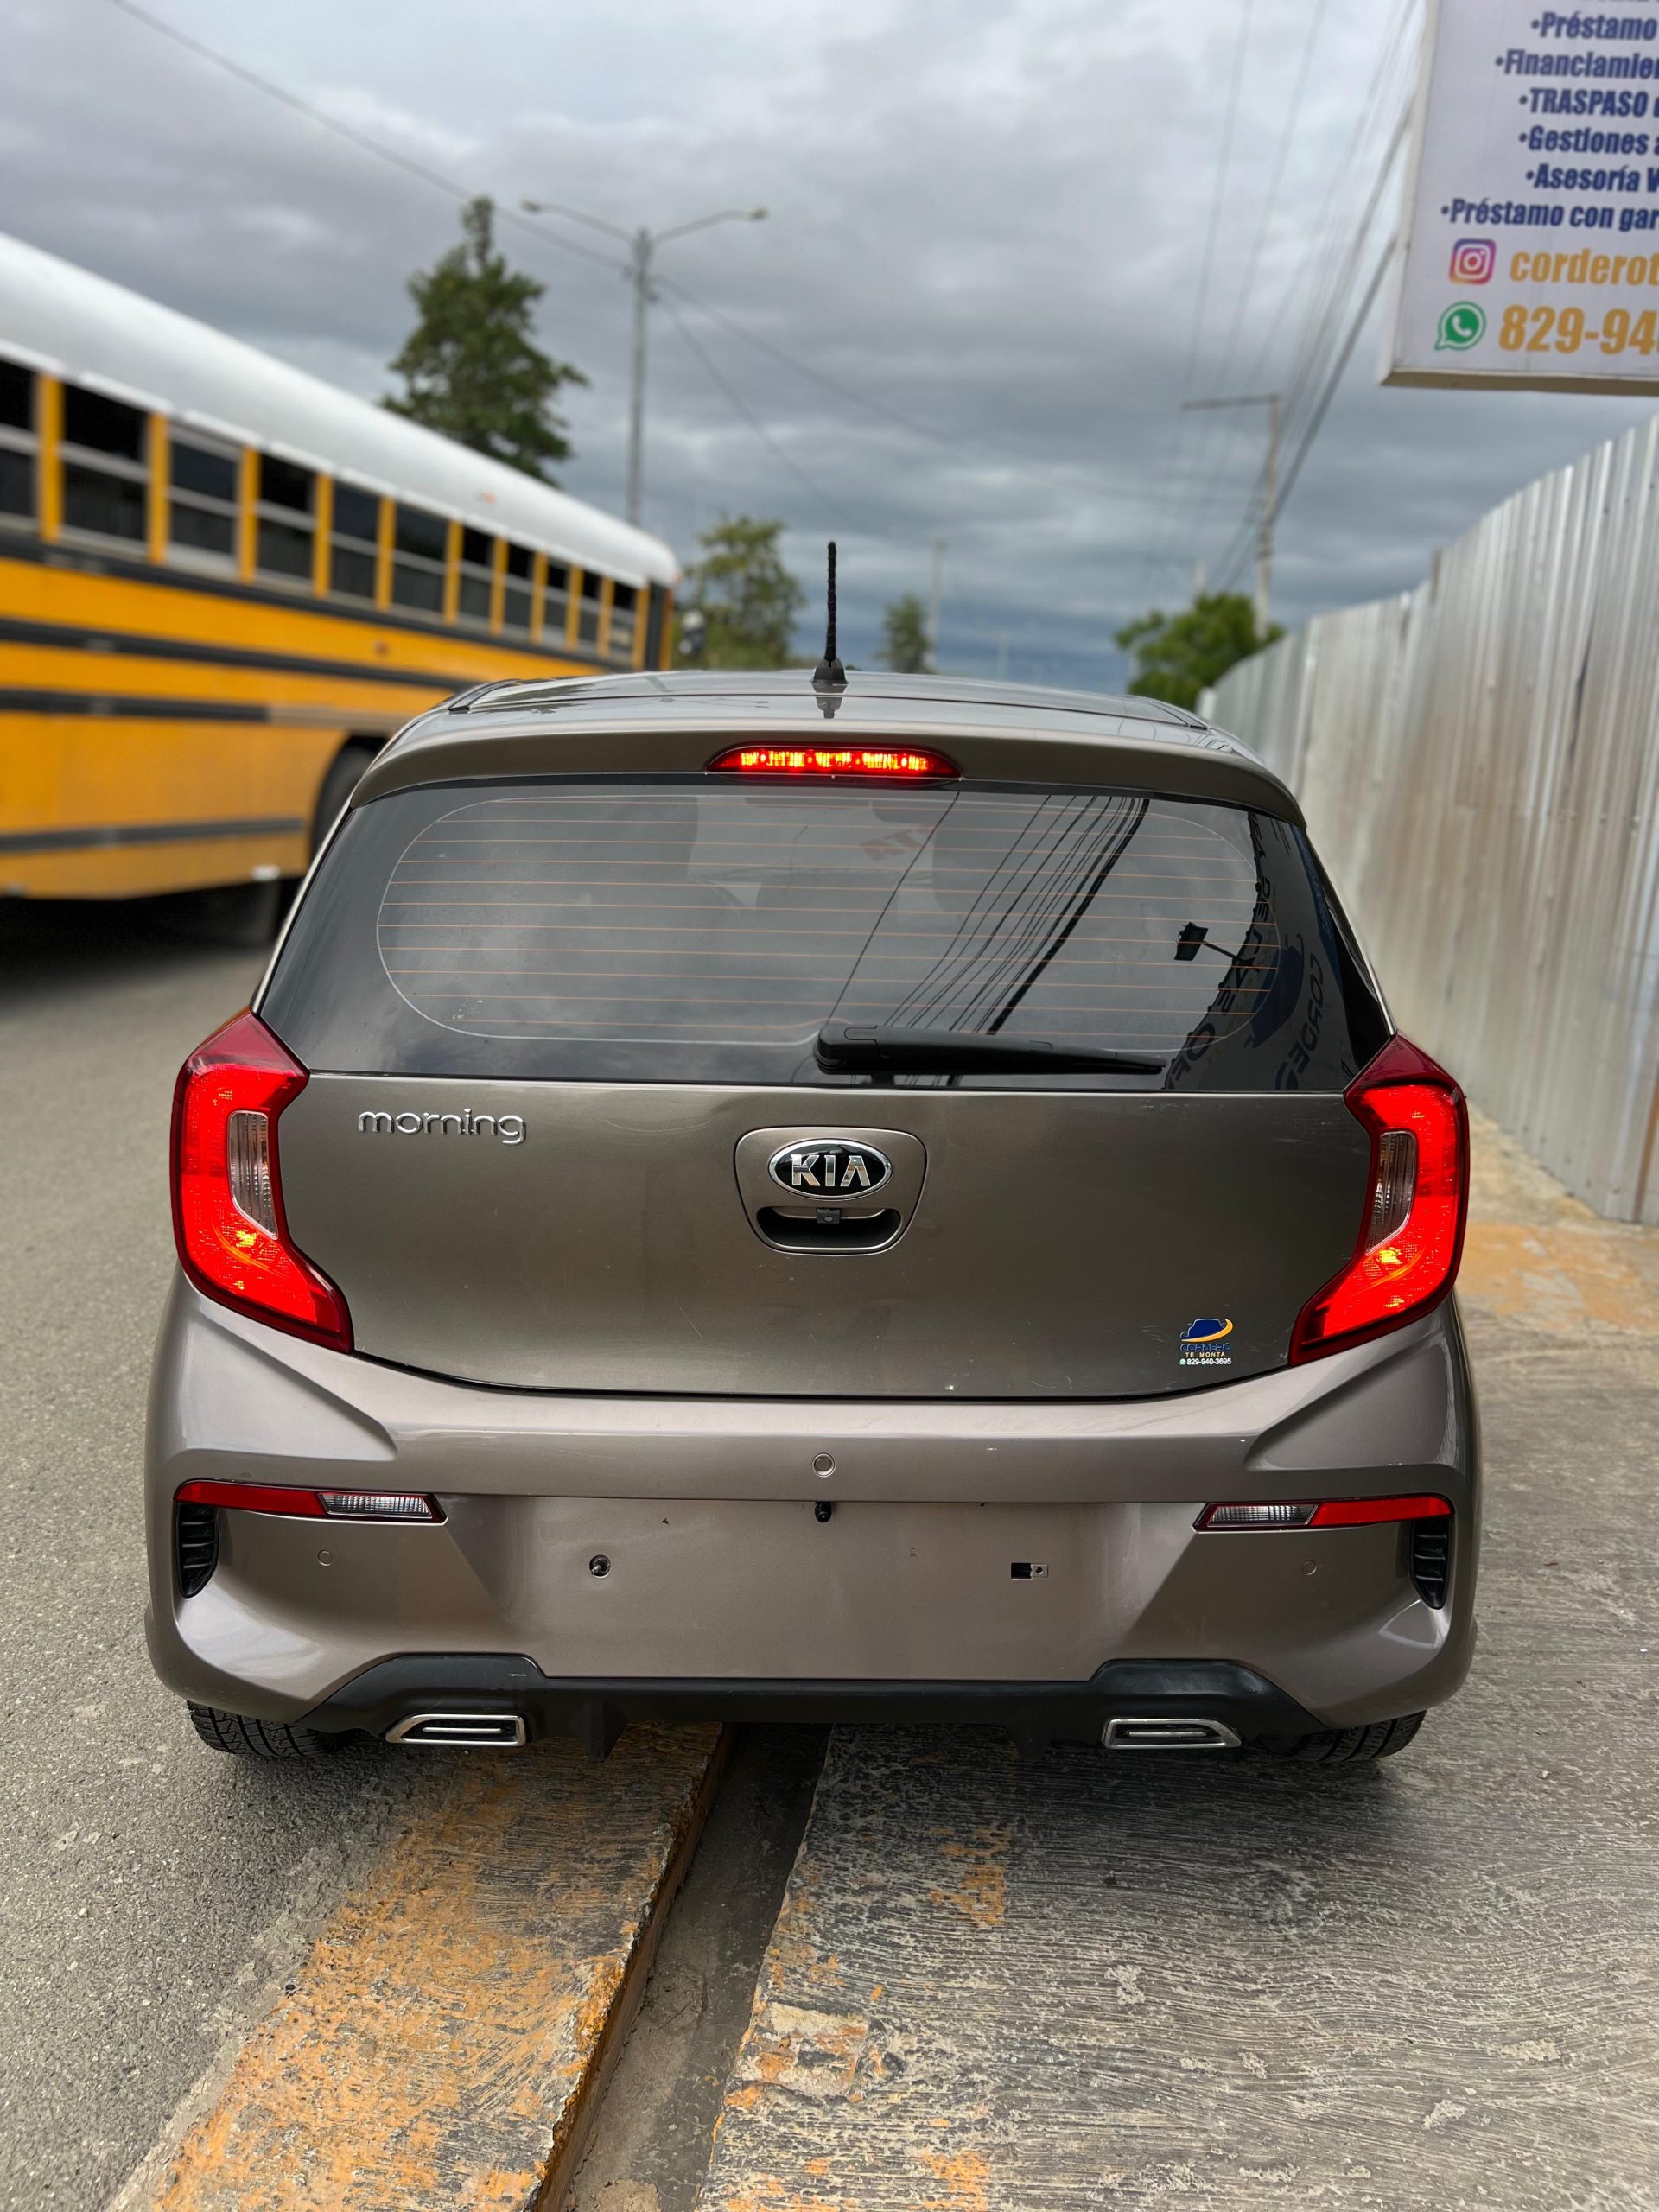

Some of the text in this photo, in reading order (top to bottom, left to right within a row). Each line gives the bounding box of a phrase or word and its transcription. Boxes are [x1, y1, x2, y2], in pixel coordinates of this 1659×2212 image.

[1569, 206, 1615, 229] con
[1498, 304, 1659, 355] 829-94
[358, 1108, 526, 1144] morning
[791, 1154, 871, 1187] KIA
[1180, 1343, 1231, 1352] CORDERO
